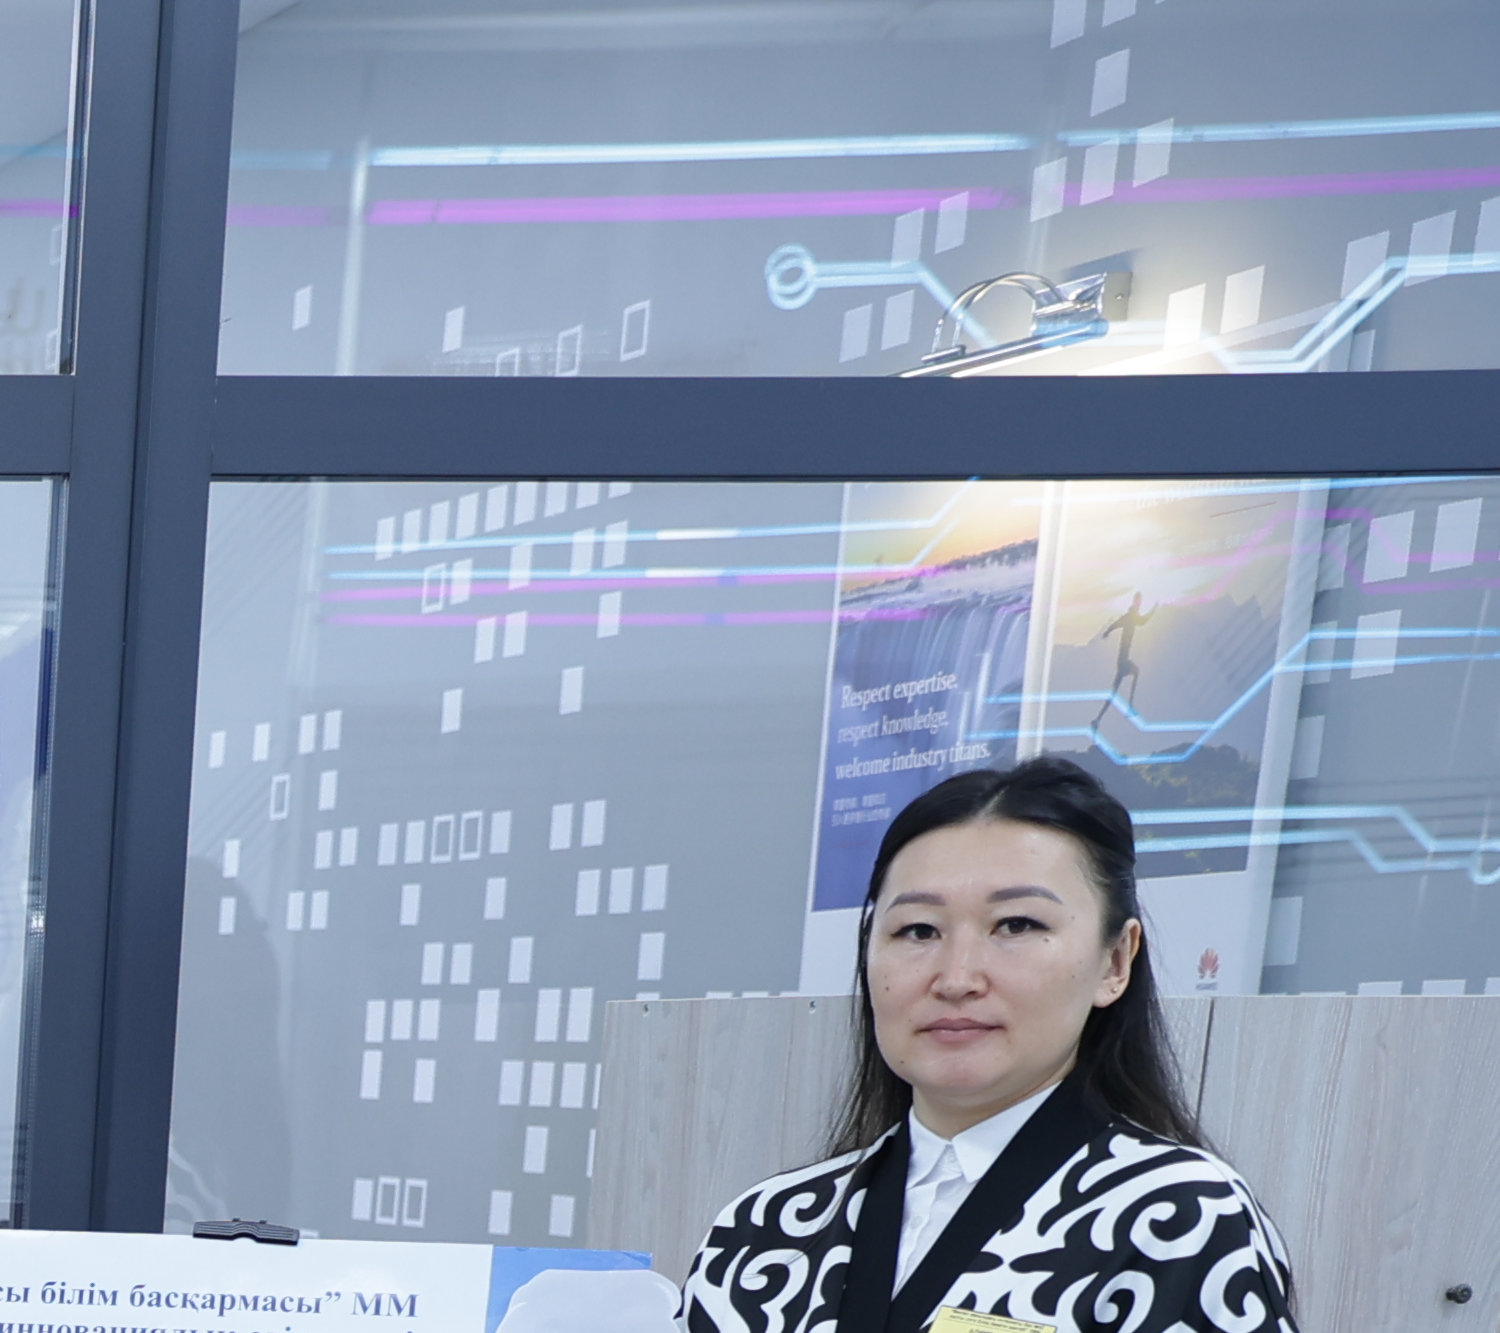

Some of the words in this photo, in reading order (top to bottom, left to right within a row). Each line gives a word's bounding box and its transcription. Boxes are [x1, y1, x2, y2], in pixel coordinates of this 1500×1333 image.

[841, 682, 890, 711] Respect
[893, 670, 959, 703] expertise.
[838, 720, 879, 747] respect
[835, 757, 890, 780] welcome
[892, 747, 947, 771] industry
[949, 741, 992, 764] titans.
[40, 1281, 120, 1308] білім
[129, 1283, 342, 1318] басқармасы”
[351, 1291, 420, 1318] ММ
